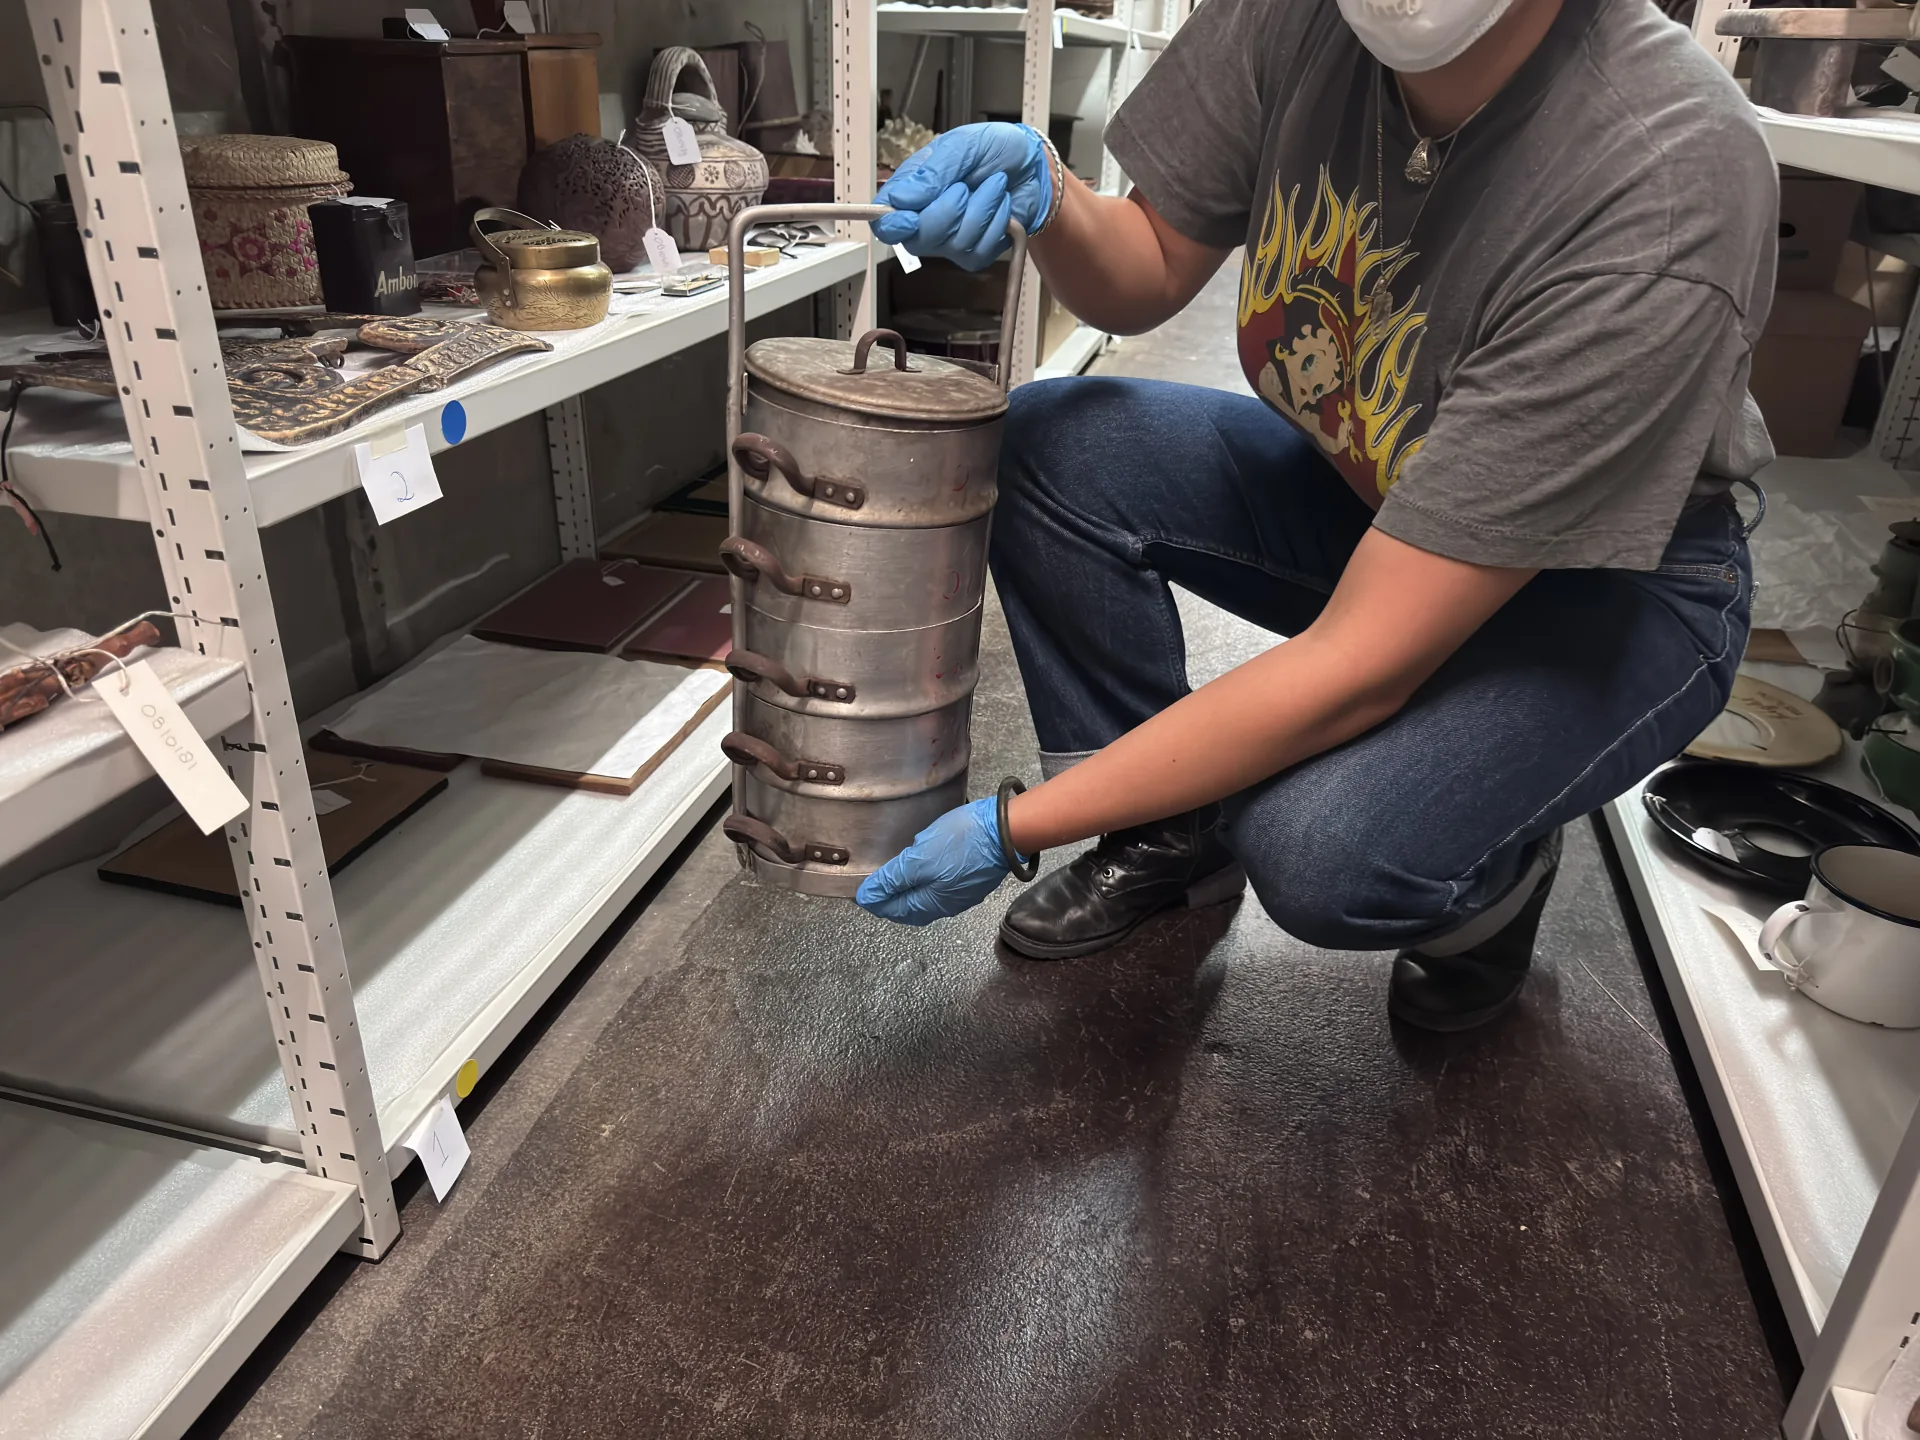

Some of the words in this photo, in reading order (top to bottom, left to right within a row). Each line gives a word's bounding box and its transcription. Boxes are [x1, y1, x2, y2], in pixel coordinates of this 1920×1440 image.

[390, 470, 415, 502] 2
[140, 704, 198, 771] 0810181
[432, 1130, 449, 1168] 1
